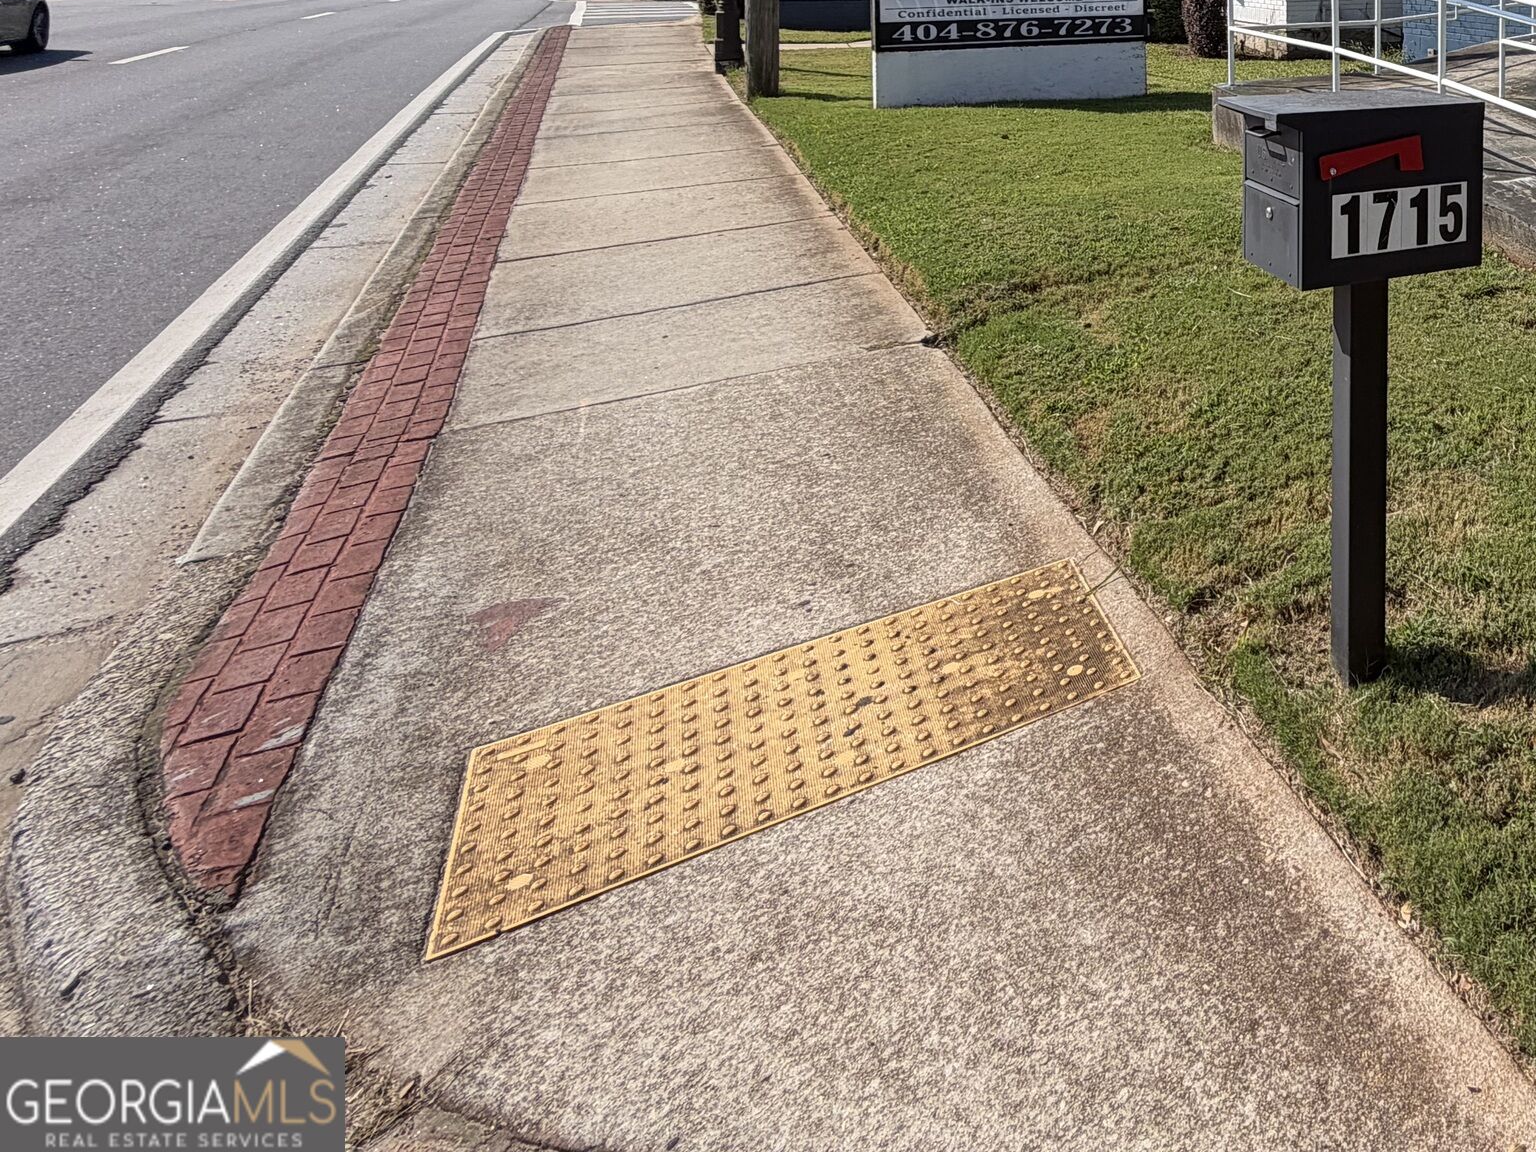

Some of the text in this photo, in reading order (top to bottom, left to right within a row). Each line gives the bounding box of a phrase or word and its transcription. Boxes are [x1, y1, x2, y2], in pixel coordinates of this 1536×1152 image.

[898, 8, 987, 18] Confidential
[1002, 5, 1061, 15] Licensed
[1074, 4, 1126, 13] Discreet
[891, 17, 1133, 42] 404-876-7273
[1340, 184, 1463, 255] 1715
